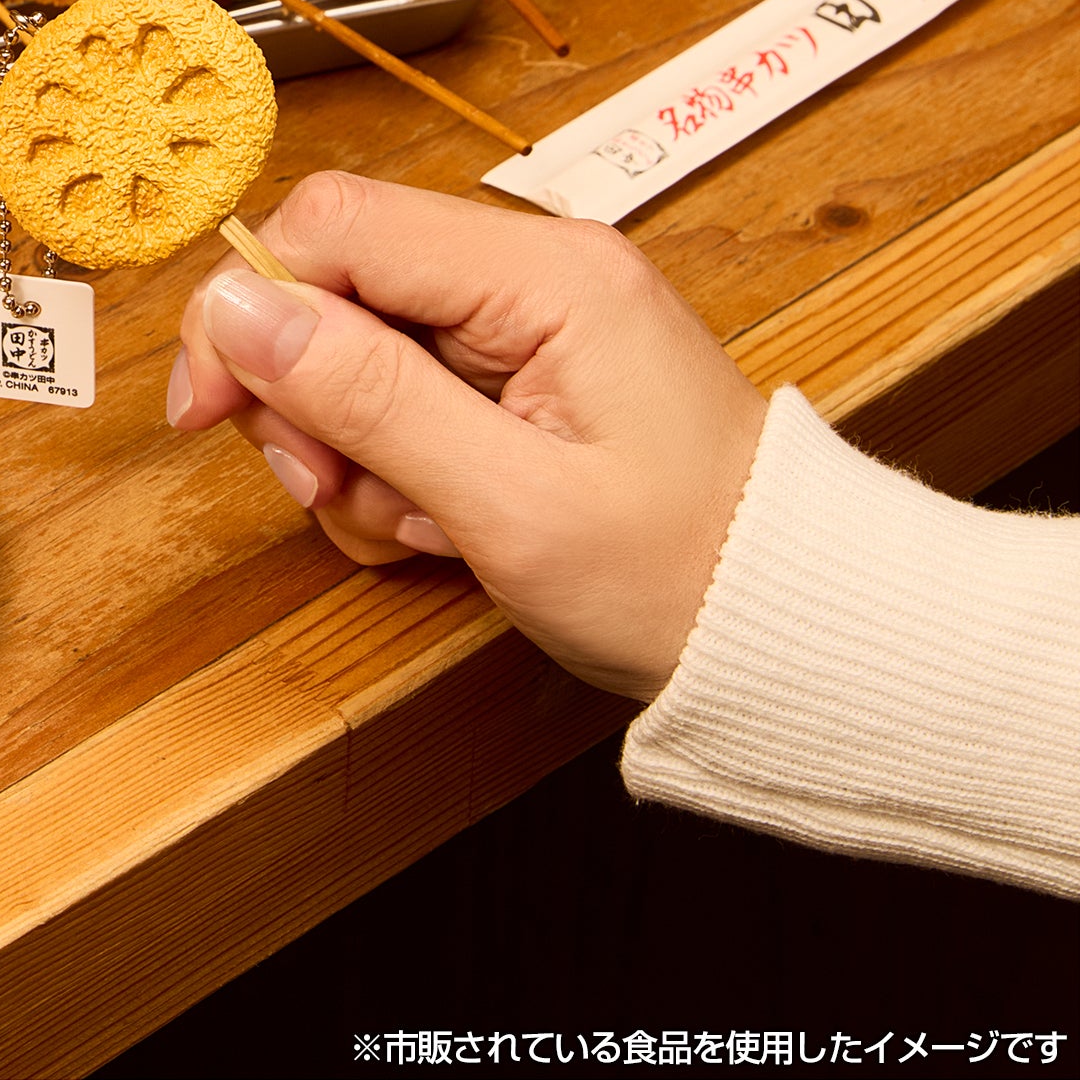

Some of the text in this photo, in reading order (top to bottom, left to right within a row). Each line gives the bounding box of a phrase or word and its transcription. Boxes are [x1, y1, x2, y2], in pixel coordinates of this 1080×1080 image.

[657, 25, 819, 142] 名物串カツ
[10, 331, 26, 362] 田中
[6, 379, 39, 392] CHINA
[48, 387, 79, 397] 67913
